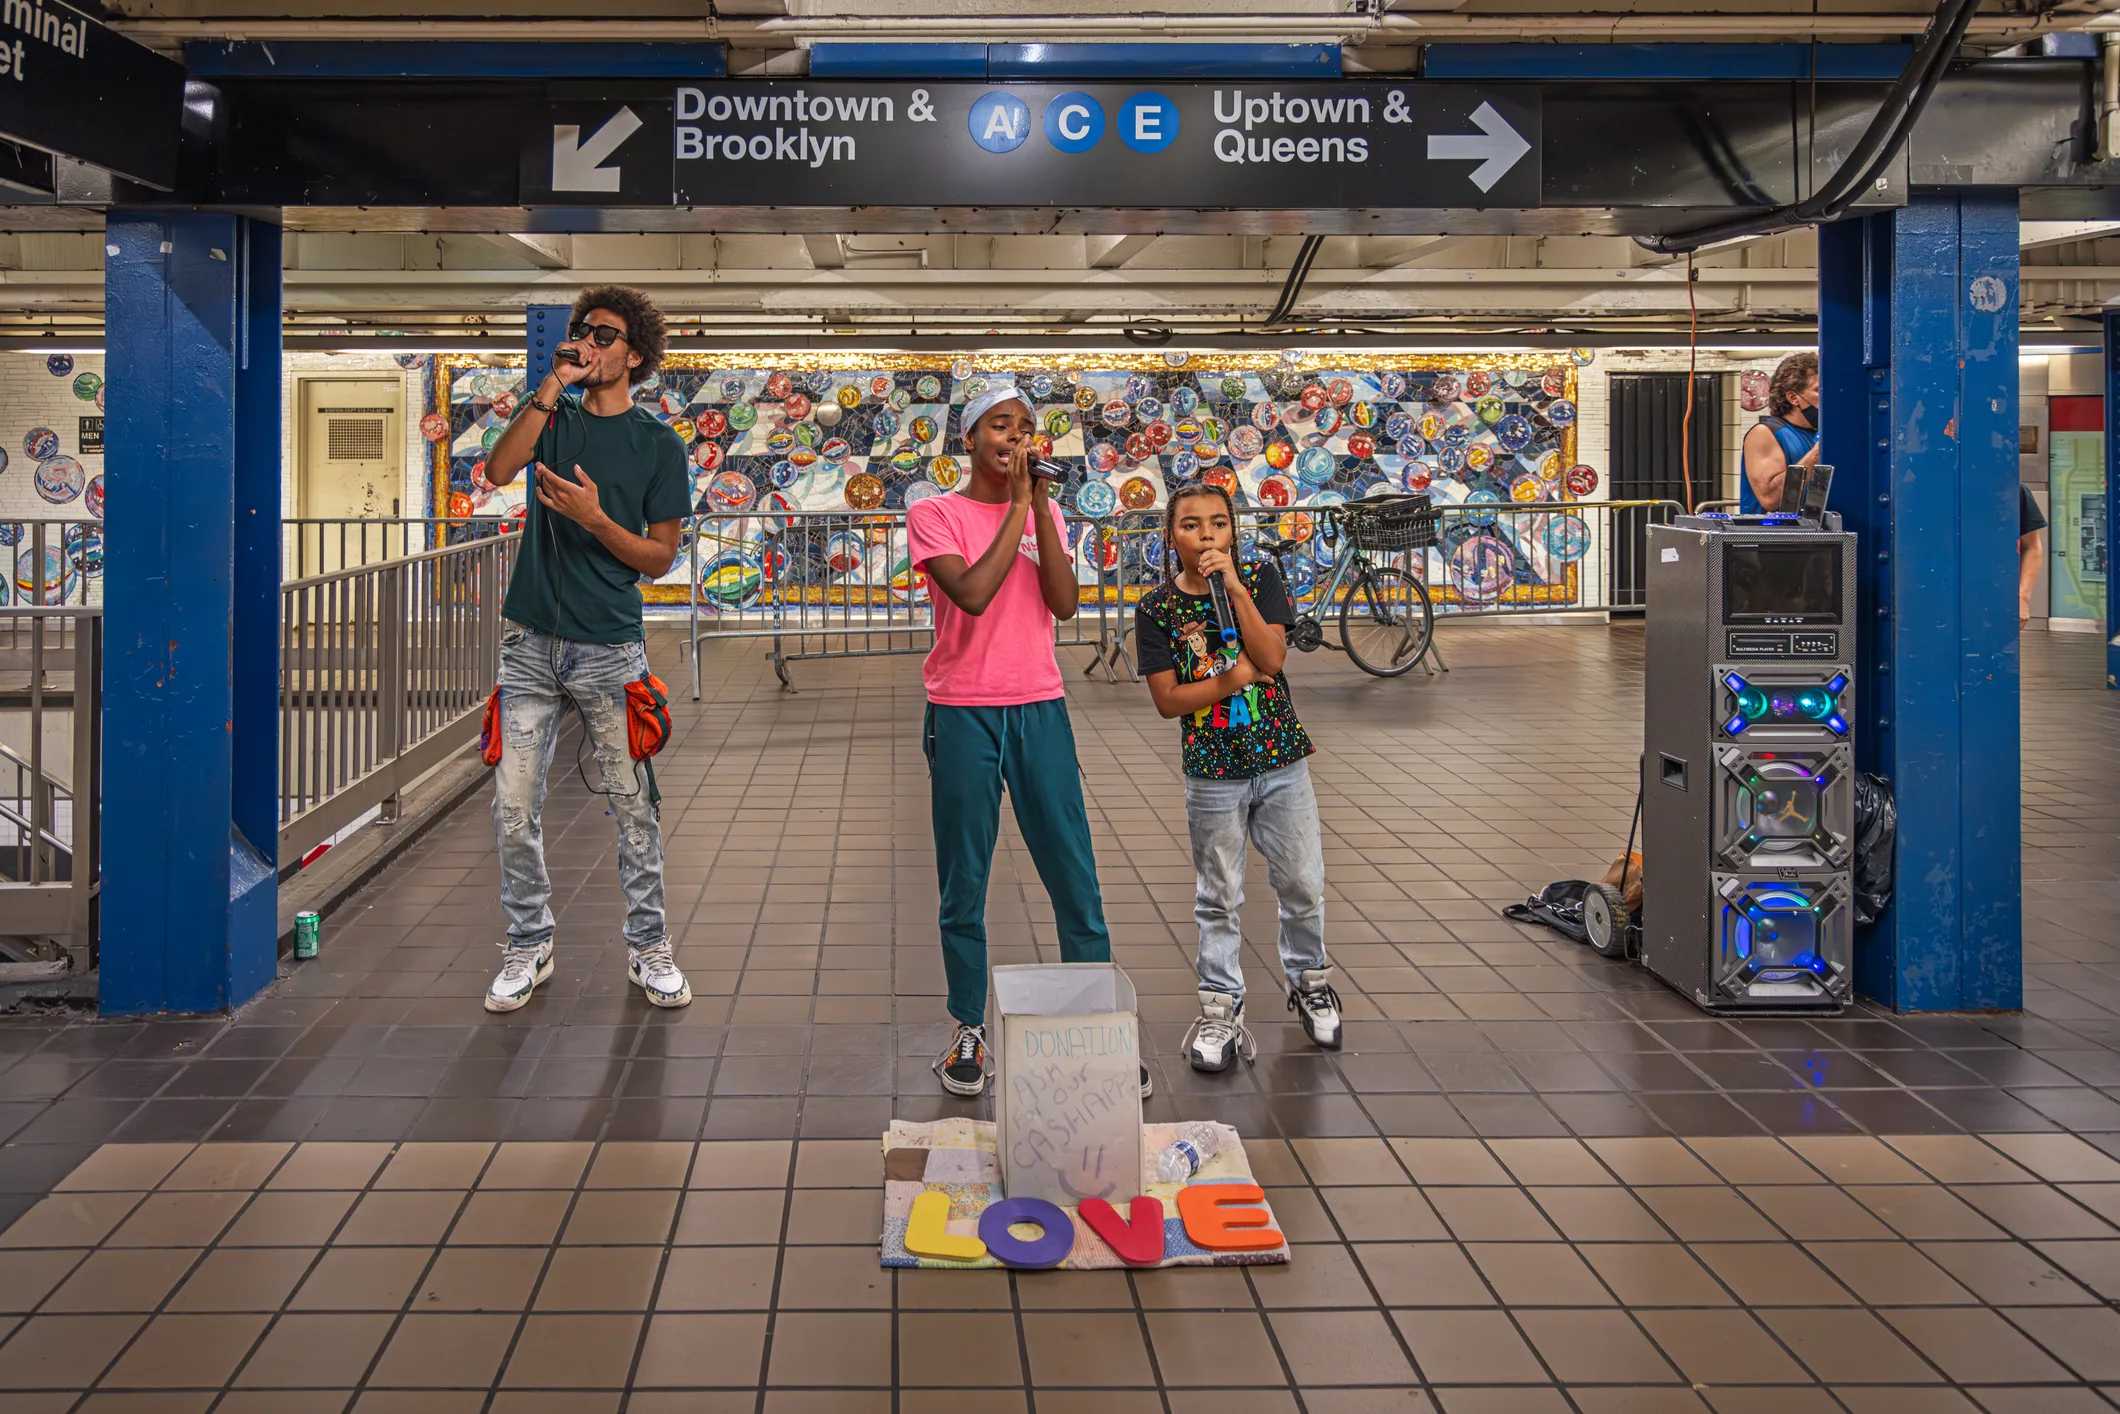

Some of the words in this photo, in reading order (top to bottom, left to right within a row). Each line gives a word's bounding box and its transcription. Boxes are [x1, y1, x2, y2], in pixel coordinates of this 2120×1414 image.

[3, 0, 87, 59] minal
[676, 87, 894, 121] Downtown
[907, 88, 937, 122] &
[983, 105, 1016, 139] A
[1058, 104, 1090, 140] C
[1135, 105, 1161, 140] E
[1213, 89, 1370, 131] Uptown
[1383, 90, 1413, 124] &
[676, 126, 856, 168] Brooklyn
[1213, 128, 1369, 164] Queens
[81, 431, 100, 440] MEN
[1194, 686, 1261, 731] PLAY
[1025, 1022, 1133, 1057] DONATION
[904, 1183, 1285, 1268] LOVE
